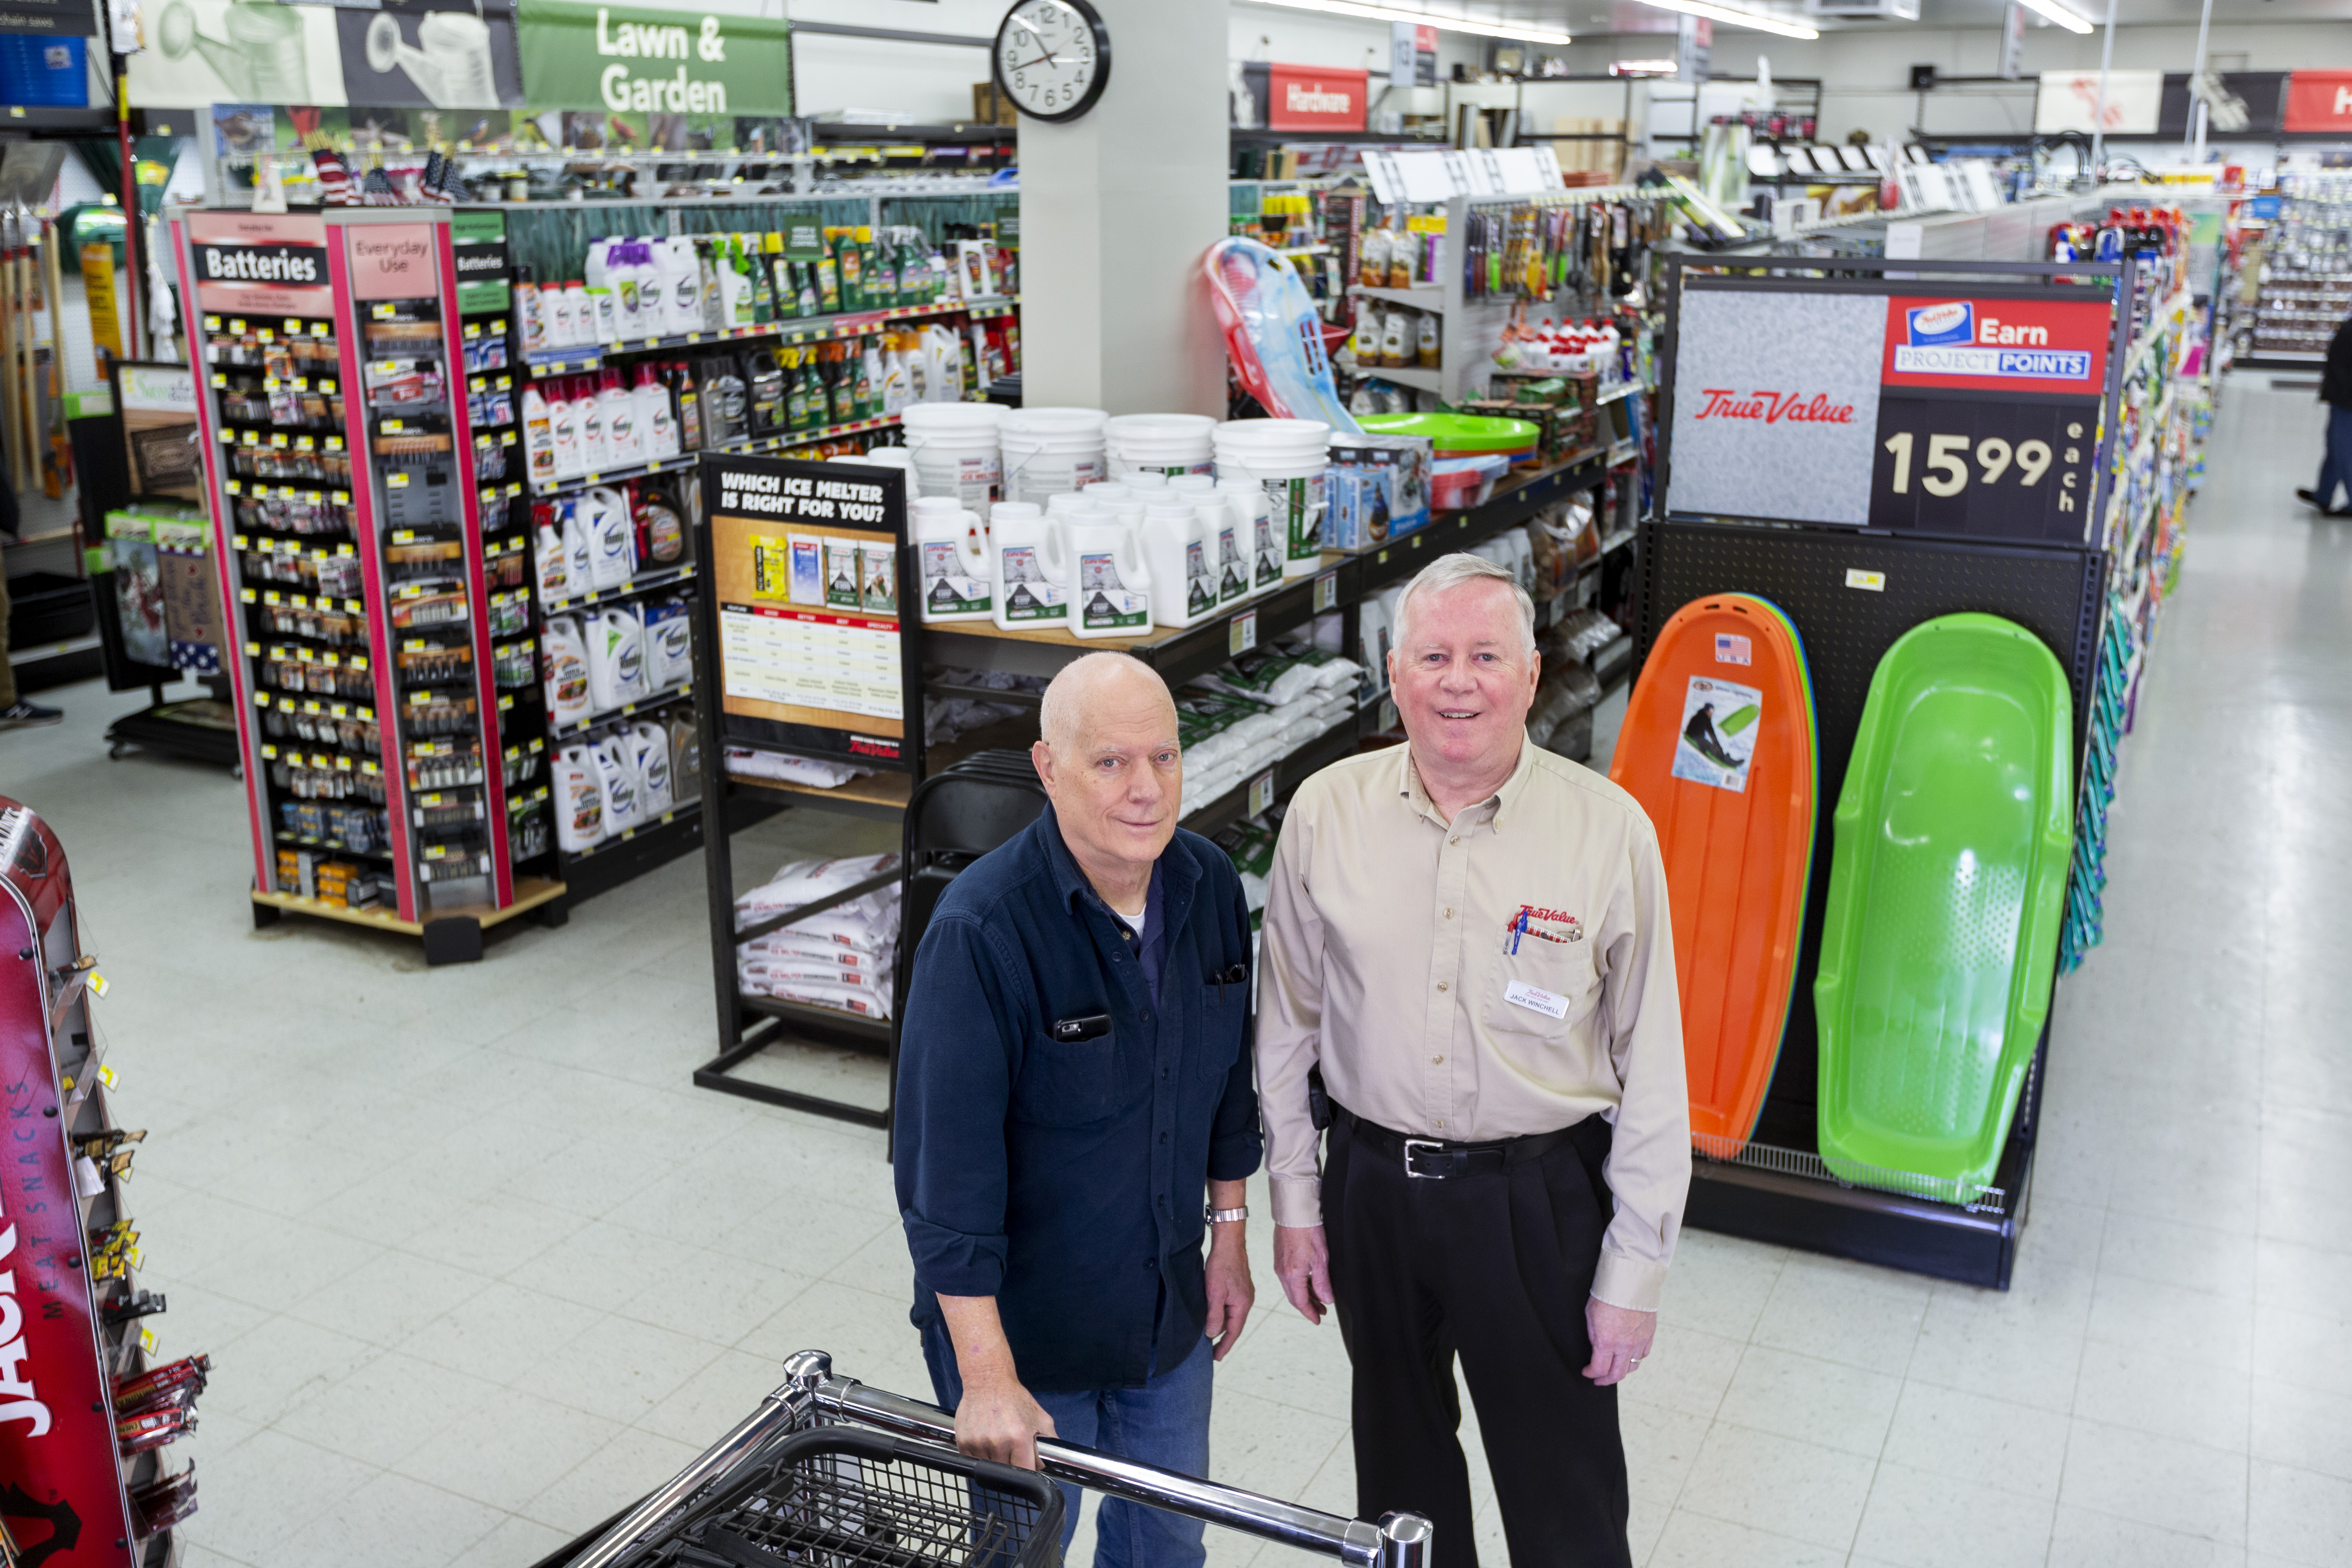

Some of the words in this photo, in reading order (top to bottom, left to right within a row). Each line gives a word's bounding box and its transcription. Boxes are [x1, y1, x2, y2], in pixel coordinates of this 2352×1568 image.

[1040, 6, 1055, 24] 12
[596, 8, 690, 58] Lawn
[698, 16, 726, 61] &
[1013, 29, 1029, 47] 10
[1074, 26, 1085, 44] 2
[601, 63, 727, 113] Garden
[1015, 71, 1025, 89] 8
[1074, 70, 1085, 87] 4
[1029, 85, 1039, 101] 7
[1045, 89, 1056, 107] 6
[1062, 83, 1072, 101] 5
[1287, 83, 1350, 114] Hardware
[356, 238, 429, 259] Everyday
[206, 247, 317, 281] Batteries
[379, 259, 410, 273] Use
[457, 254, 503, 271] Batteries
[1979, 317, 2048, 345] Earn
[1900, 350, 1995, 370] PROJECT
[2000, 352, 2083, 374] POINTS
[721, 471, 780, 494] WHICH
[784, 477, 813, 496] ICE
[816, 480, 883, 503] MELTER
[722, 491, 738, 509] IS
[741, 493, 796, 514] RIGHT
[798, 498, 835, 518] FOR
[839, 502, 885, 523] YOU?
[1510, 994, 1527, 1003] JACK
[1528, 1000, 1559, 1015] WINCHELL
[6, 1081, 47, 1214] SNACKS
[30, 1235, 64, 1319] MEAT
